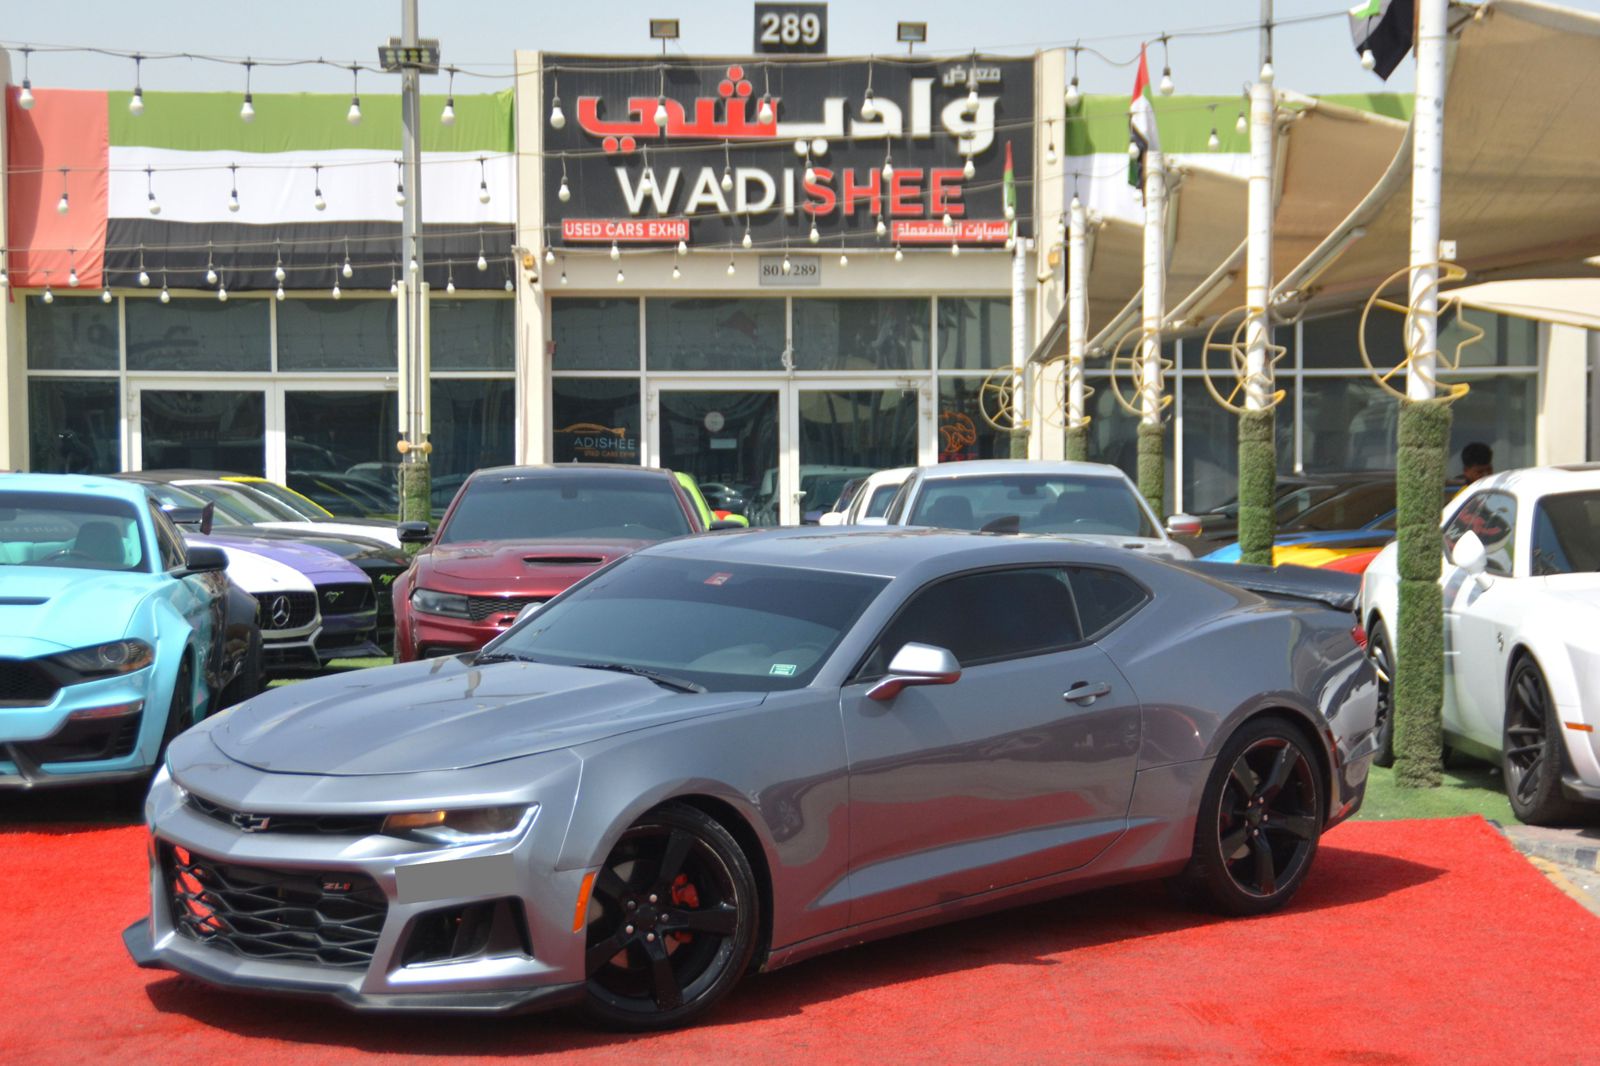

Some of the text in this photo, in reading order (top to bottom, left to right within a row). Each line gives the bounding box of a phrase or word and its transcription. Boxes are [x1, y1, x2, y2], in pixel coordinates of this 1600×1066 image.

[761, 12, 820, 44] 289
[615, 166, 966, 216] WADISHEE
[564, 222, 687, 237] USED CARS EXHB
